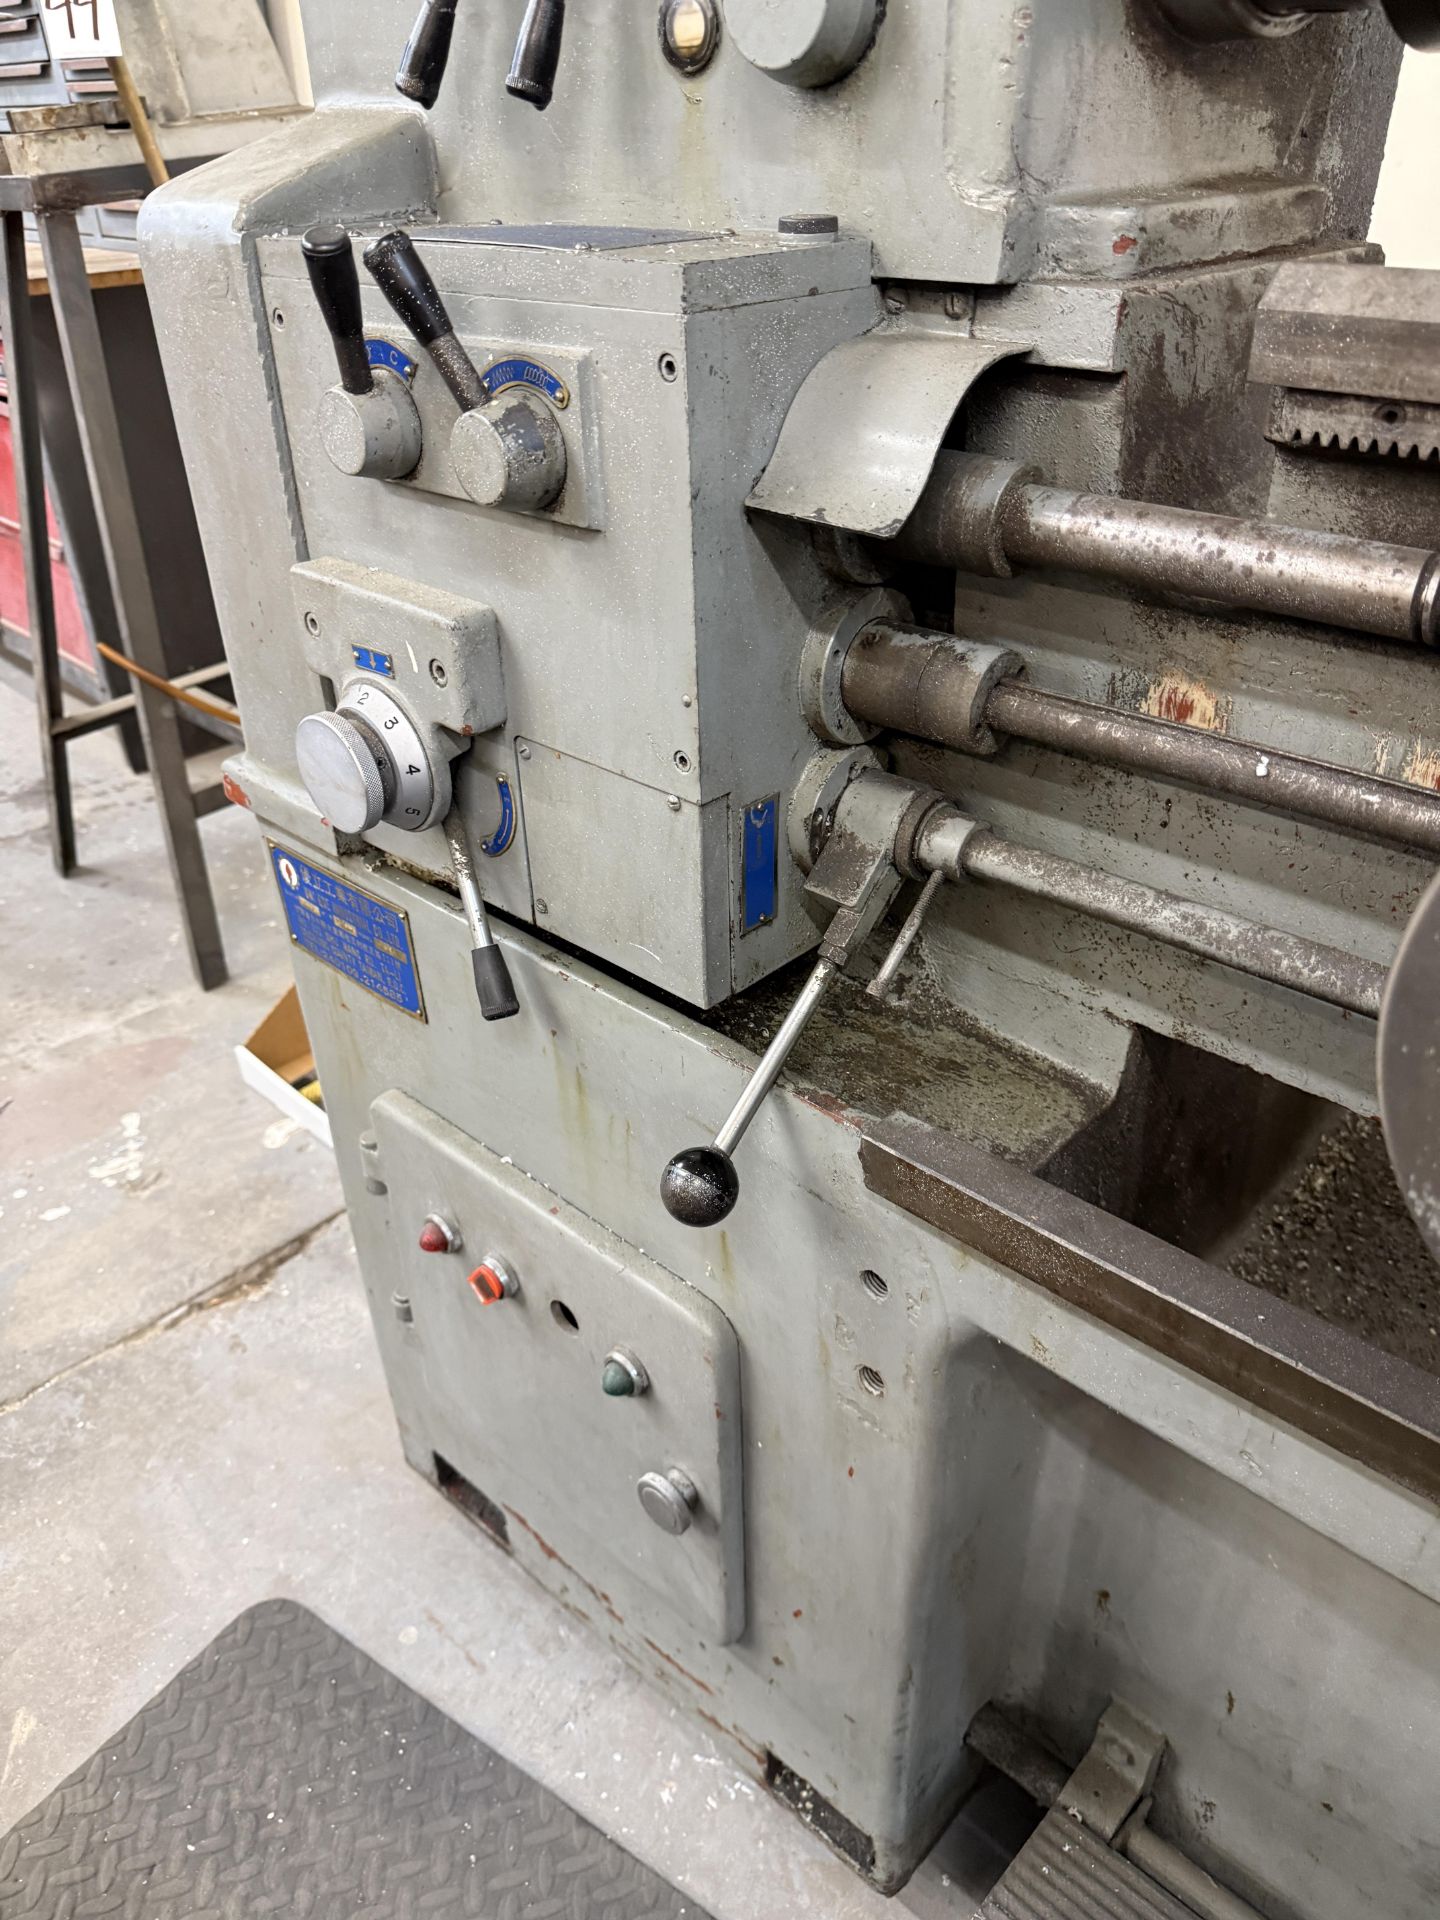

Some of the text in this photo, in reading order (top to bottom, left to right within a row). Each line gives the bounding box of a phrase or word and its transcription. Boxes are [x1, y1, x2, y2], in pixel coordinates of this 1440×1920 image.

[357, 692, 369, 705] 2
[384, 716, 399, 730] 3
[405, 764, 421, 776] 4
[405, 807, 420, 816] 5
